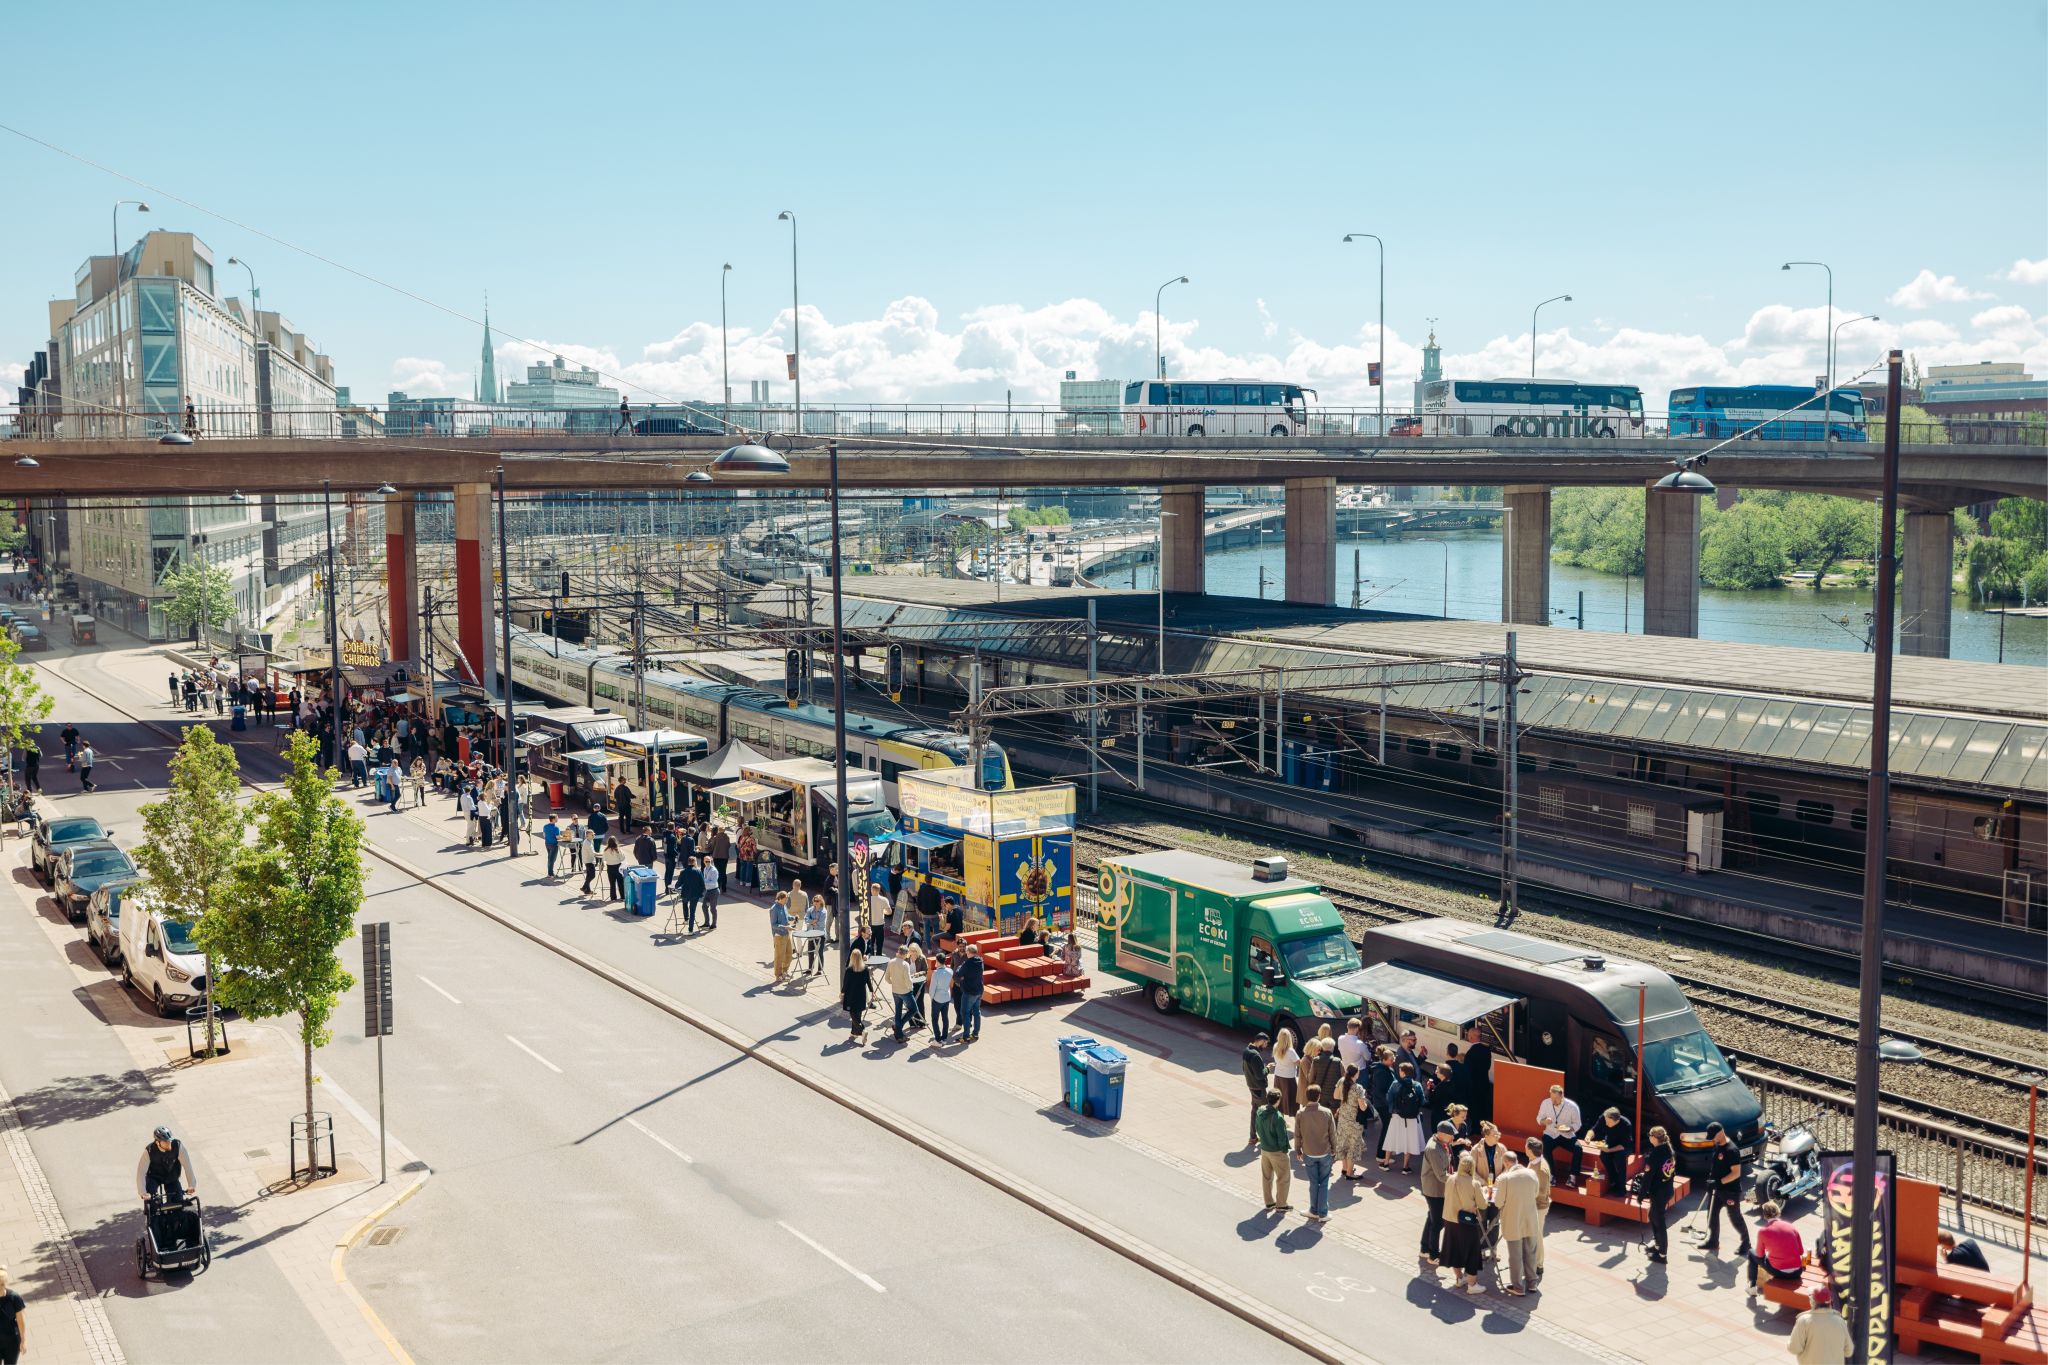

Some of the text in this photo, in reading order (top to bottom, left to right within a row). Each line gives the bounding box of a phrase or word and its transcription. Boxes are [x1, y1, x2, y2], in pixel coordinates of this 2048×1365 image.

[345, 641, 379, 655] DONUTS
[343, 653, 381, 667] CHURROS
[1199, 922, 1228, 941] ECOKI
